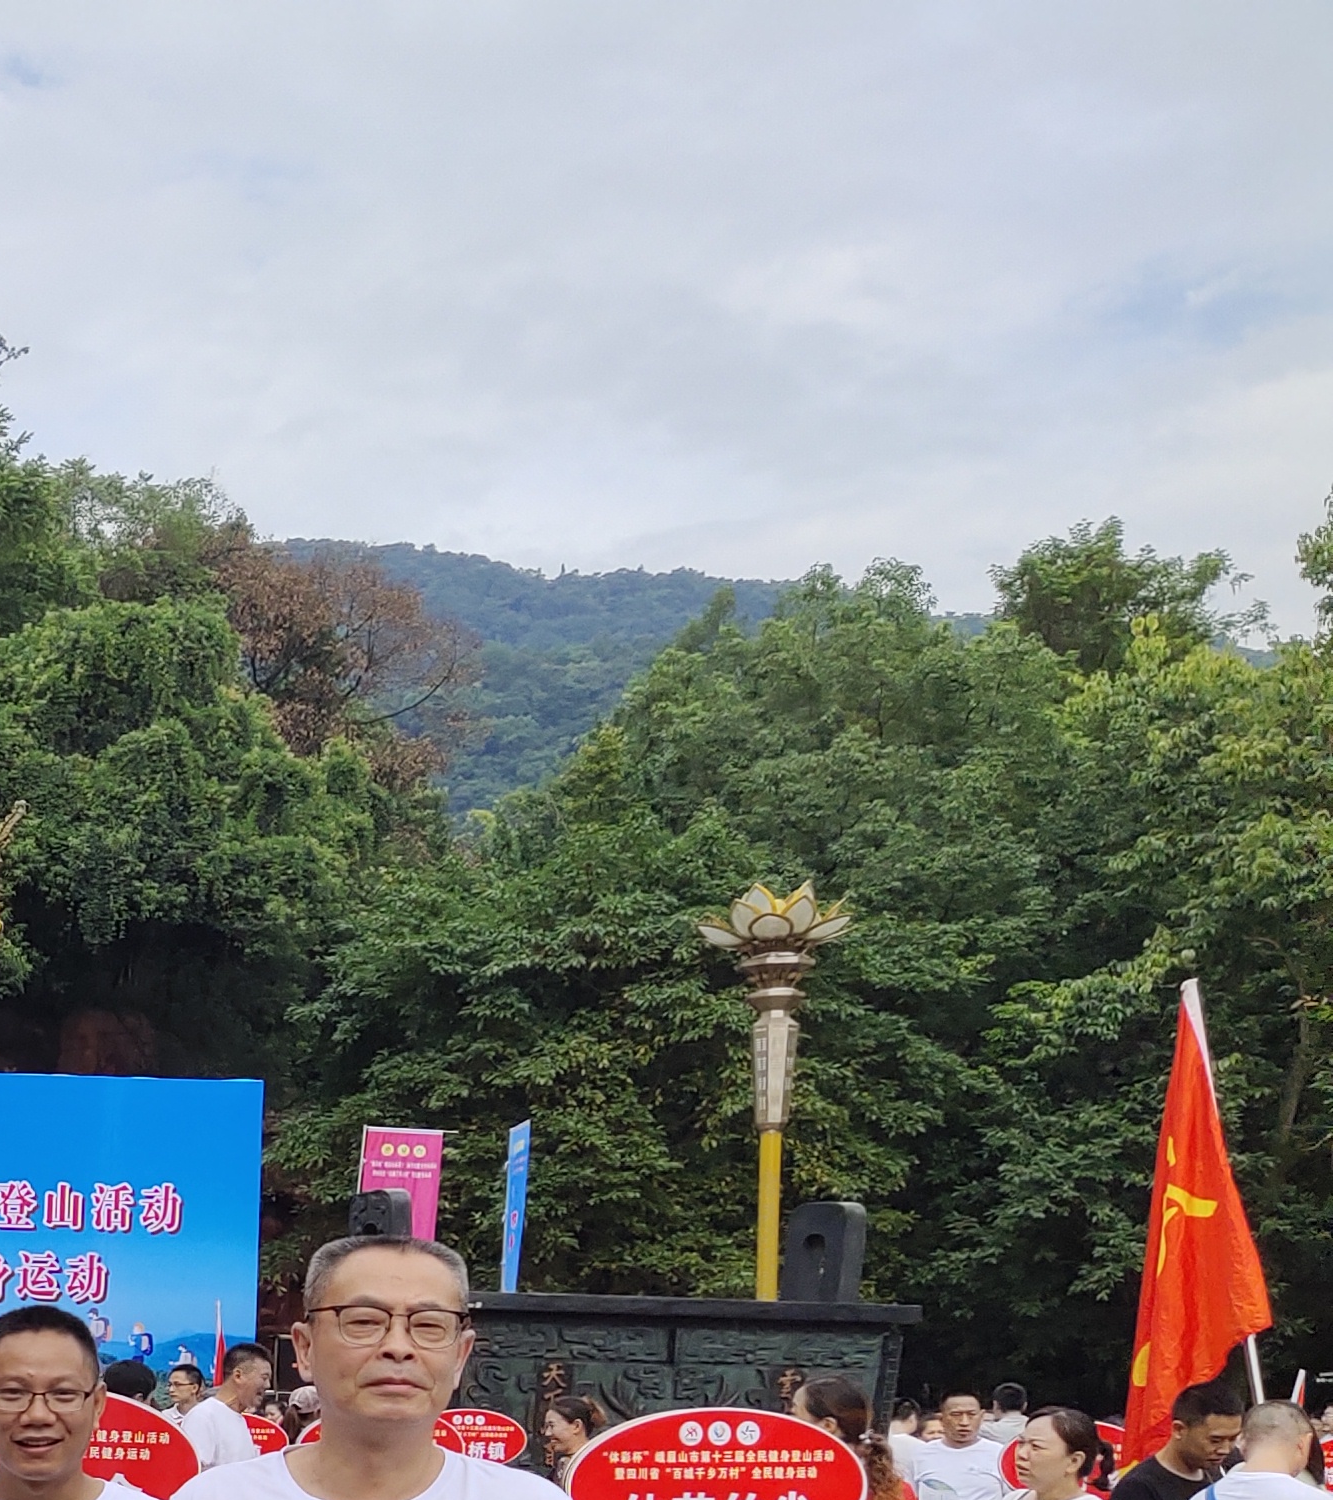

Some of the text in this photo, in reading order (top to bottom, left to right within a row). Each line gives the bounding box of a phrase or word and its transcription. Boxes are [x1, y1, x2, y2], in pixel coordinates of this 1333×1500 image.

[90, 1429, 170, 1444] 健身登山活动
[83, 1446, 151, 1460] 民健身运动
